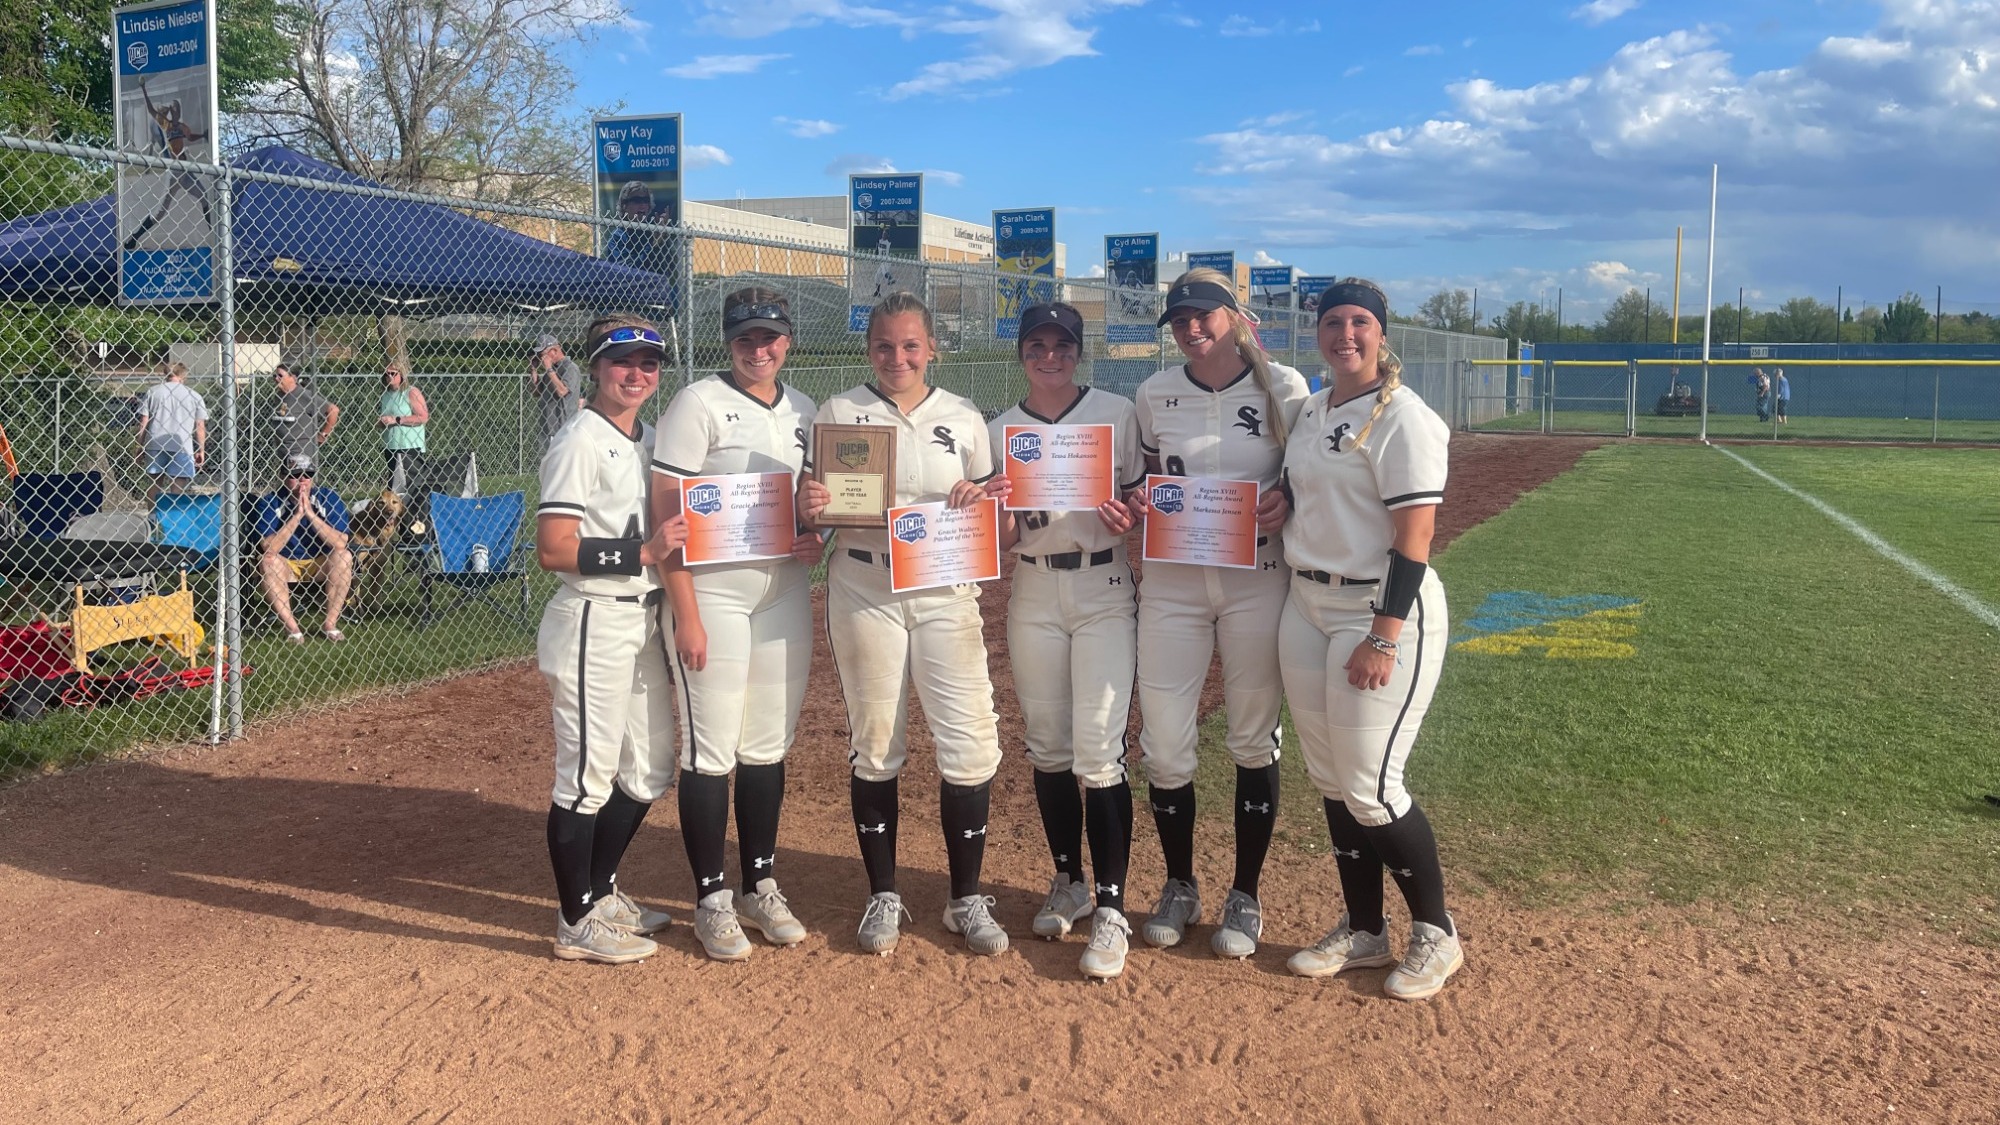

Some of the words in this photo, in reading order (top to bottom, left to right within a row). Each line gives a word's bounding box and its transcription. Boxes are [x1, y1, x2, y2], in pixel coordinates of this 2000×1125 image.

[123, 16, 165, 34] Lindsie
[168, 11, 203, 28] Nielsen
[158, 39, 198, 57] 2003-2004
[599, 127, 627, 141] Mary
[631, 126, 652, 140] Kay
[627, 144, 675, 156] Amicone
[631, 158, 669, 168] 2005-2013
[856, 181, 886, 190] Lindsey
[954, 227, 974, 240] Lifetime
[1115, 239, 1129, 247] Cyd
[840, 443, 869, 457] NJCAA
[1010, 438, 1041, 453] NJCAA
[688, 489, 721, 506] NJCAA
[1152, 488, 1184, 503] NJCAA
[895, 518, 925, 535] NJCAA
